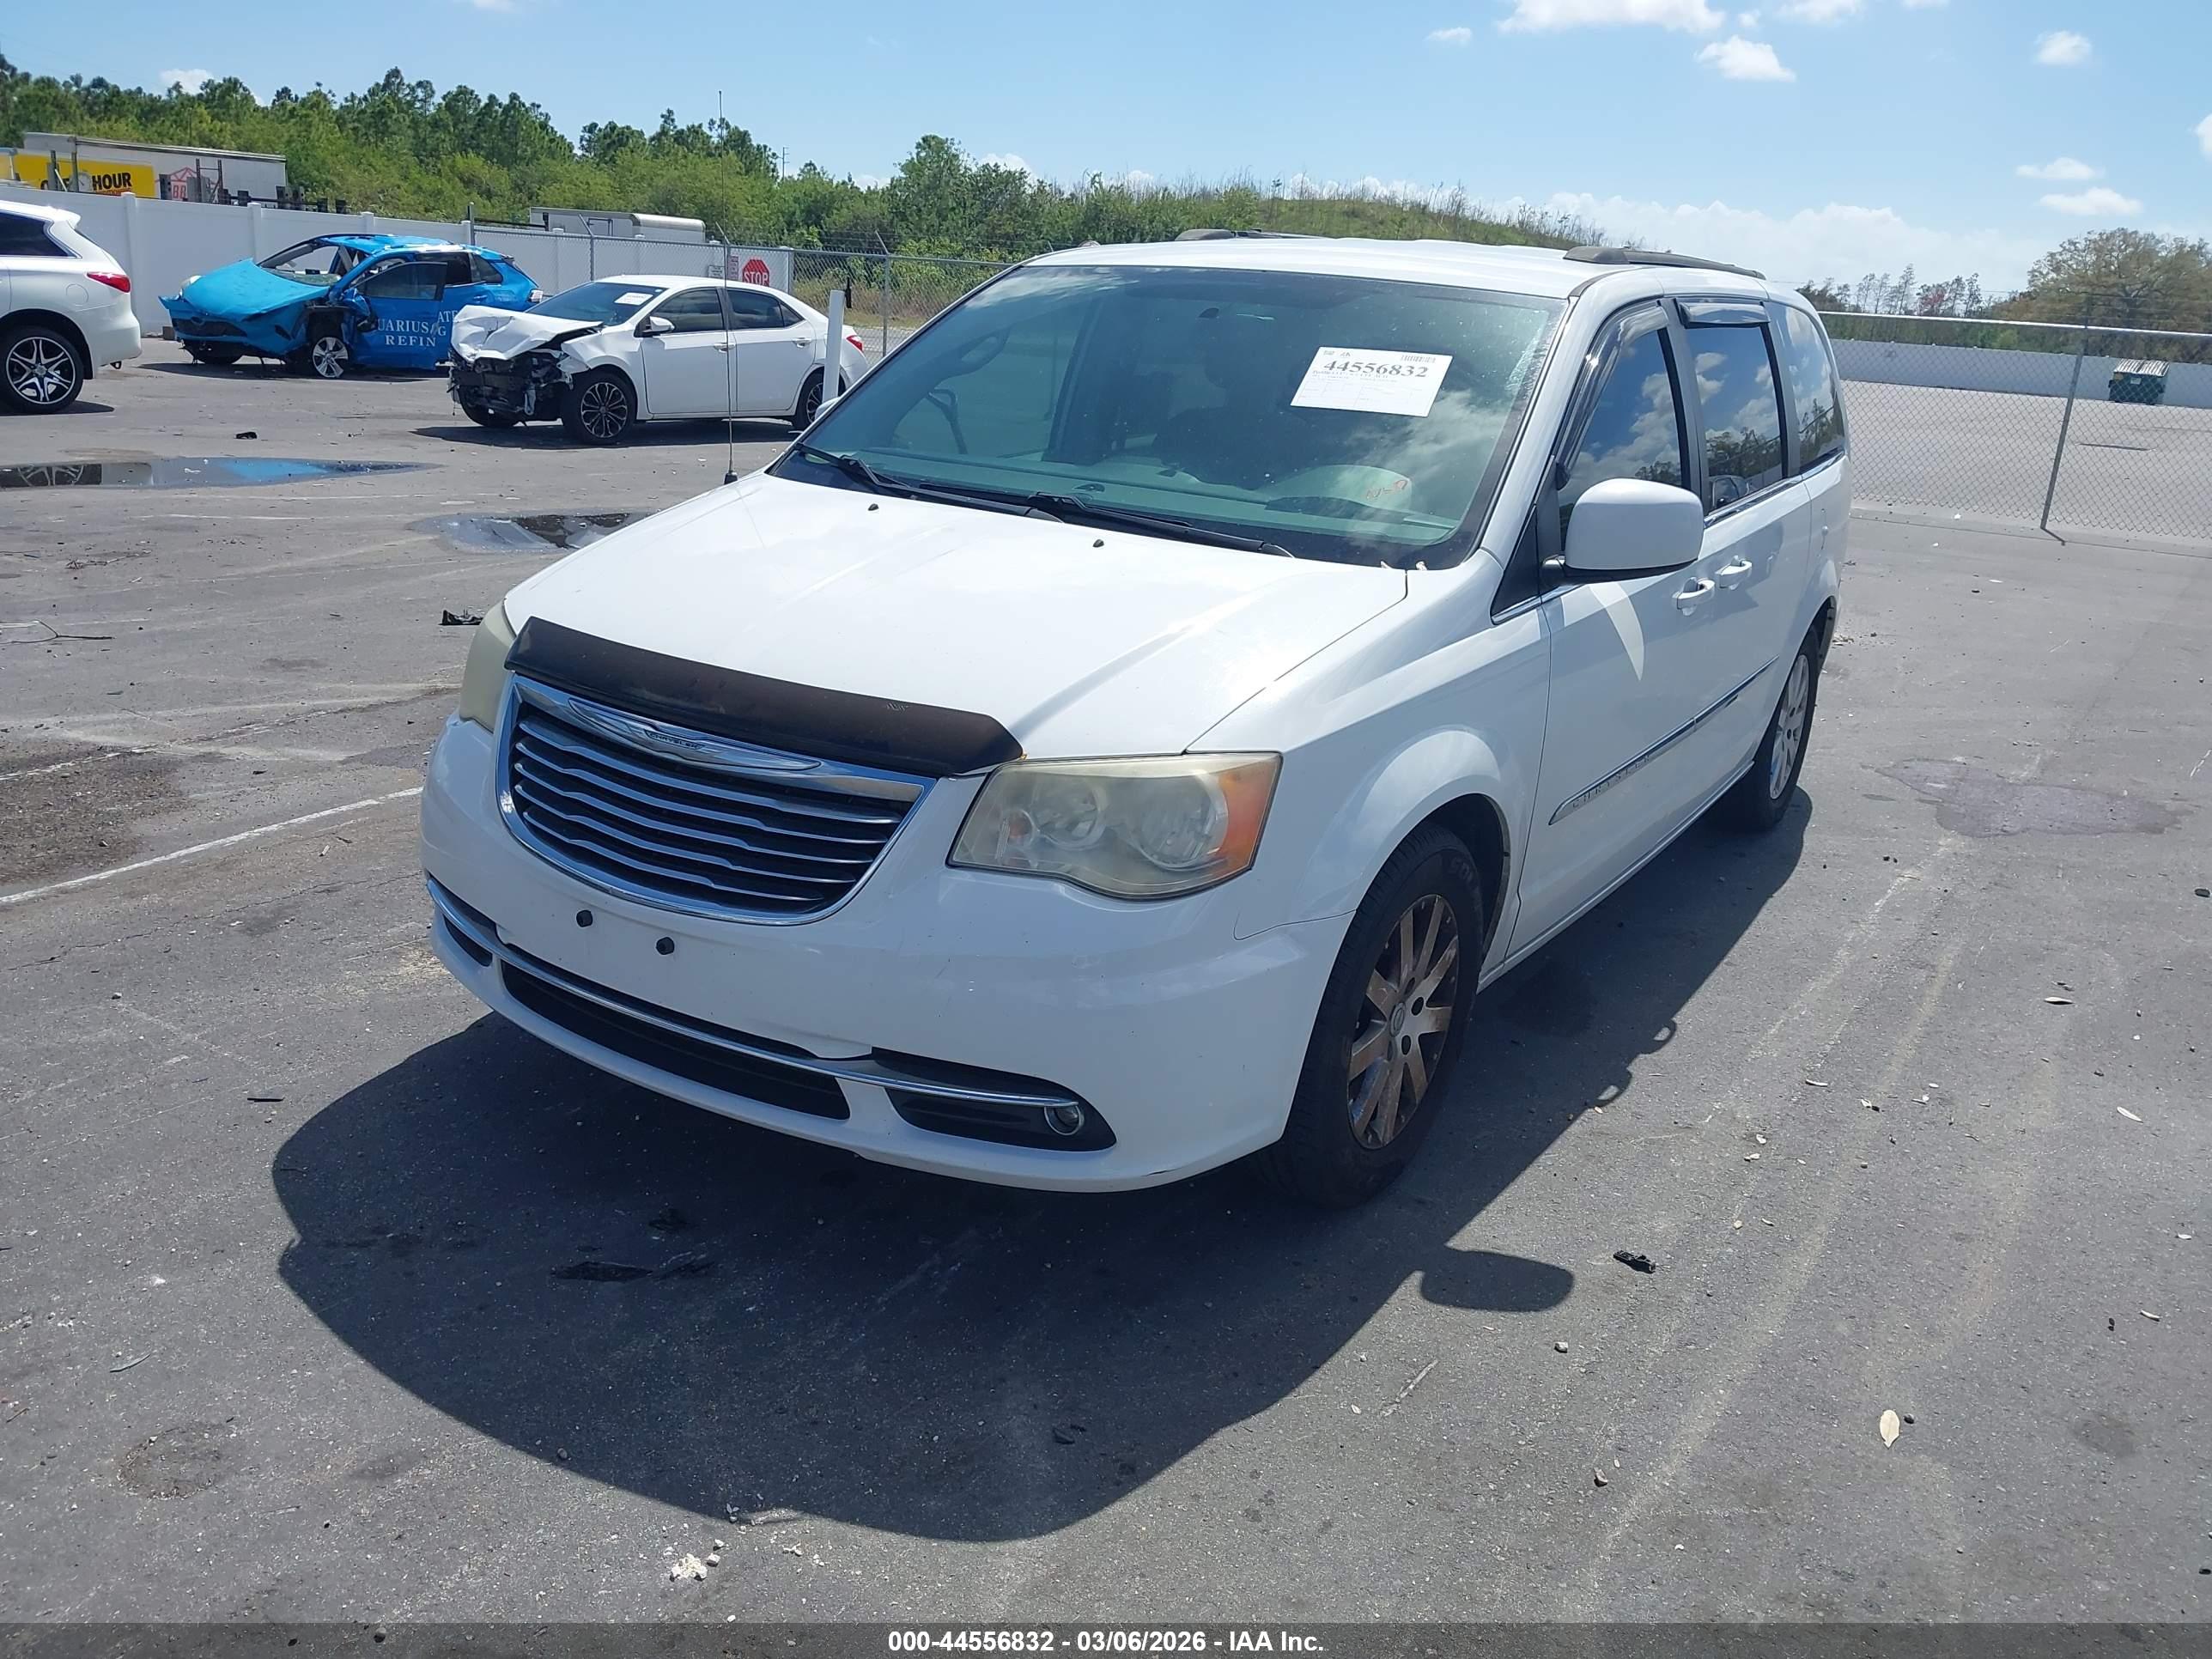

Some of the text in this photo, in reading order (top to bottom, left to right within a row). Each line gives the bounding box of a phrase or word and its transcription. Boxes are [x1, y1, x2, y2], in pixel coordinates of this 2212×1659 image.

[92, 172, 132, 191] HOUR
[744, 271, 769, 286] STOP
[385, 335, 436, 347] REFIN
[1323, 359, 1429, 378] 44556832
